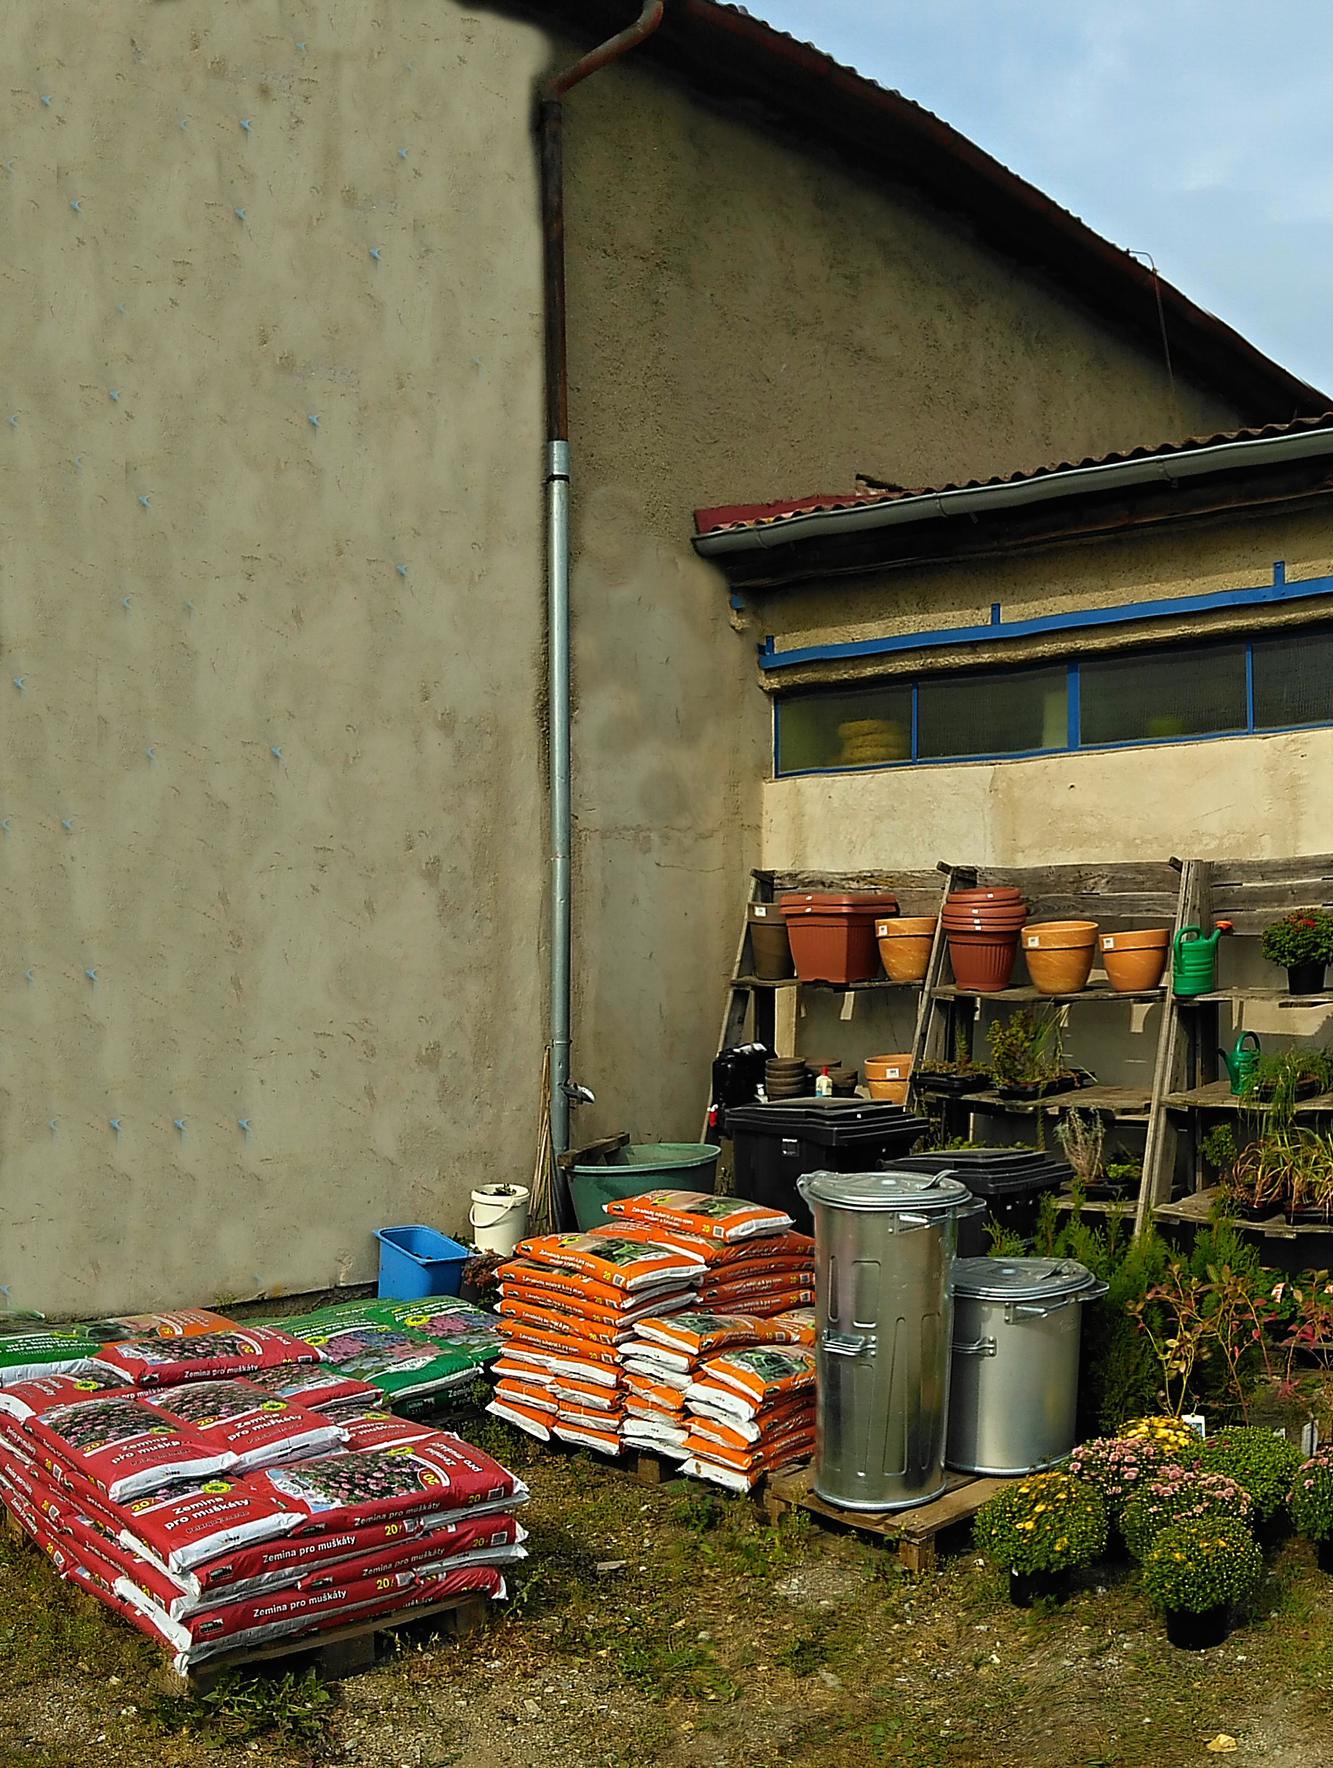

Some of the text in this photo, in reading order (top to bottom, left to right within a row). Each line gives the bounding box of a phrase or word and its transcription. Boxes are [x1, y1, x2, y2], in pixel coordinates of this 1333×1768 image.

[184, 1369, 211, 1379] Zemina
[212, 1367, 225, 1378] pro
[234, 1413, 280, 1430] Zemina
[120, 1437, 168, 1451] Zemina
[228, 1430, 250, 1441] pro
[111, 1452, 134, 1465] pro
[172, 1496, 225, 1514] Zemina
[164, 1515, 190, 1531] pro
[192, 1499, 251, 1519] muškáty
[354, 1502, 440, 1527] Zemina pro muškáty
[262, 1536, 356, 1564] Zemina pro muškáty
[362, 1562, 393, 1577] Zemina
[394, 1557, 409, 1569] pro
[253, 1590, 347, 1618] Zemina pro muškáty
